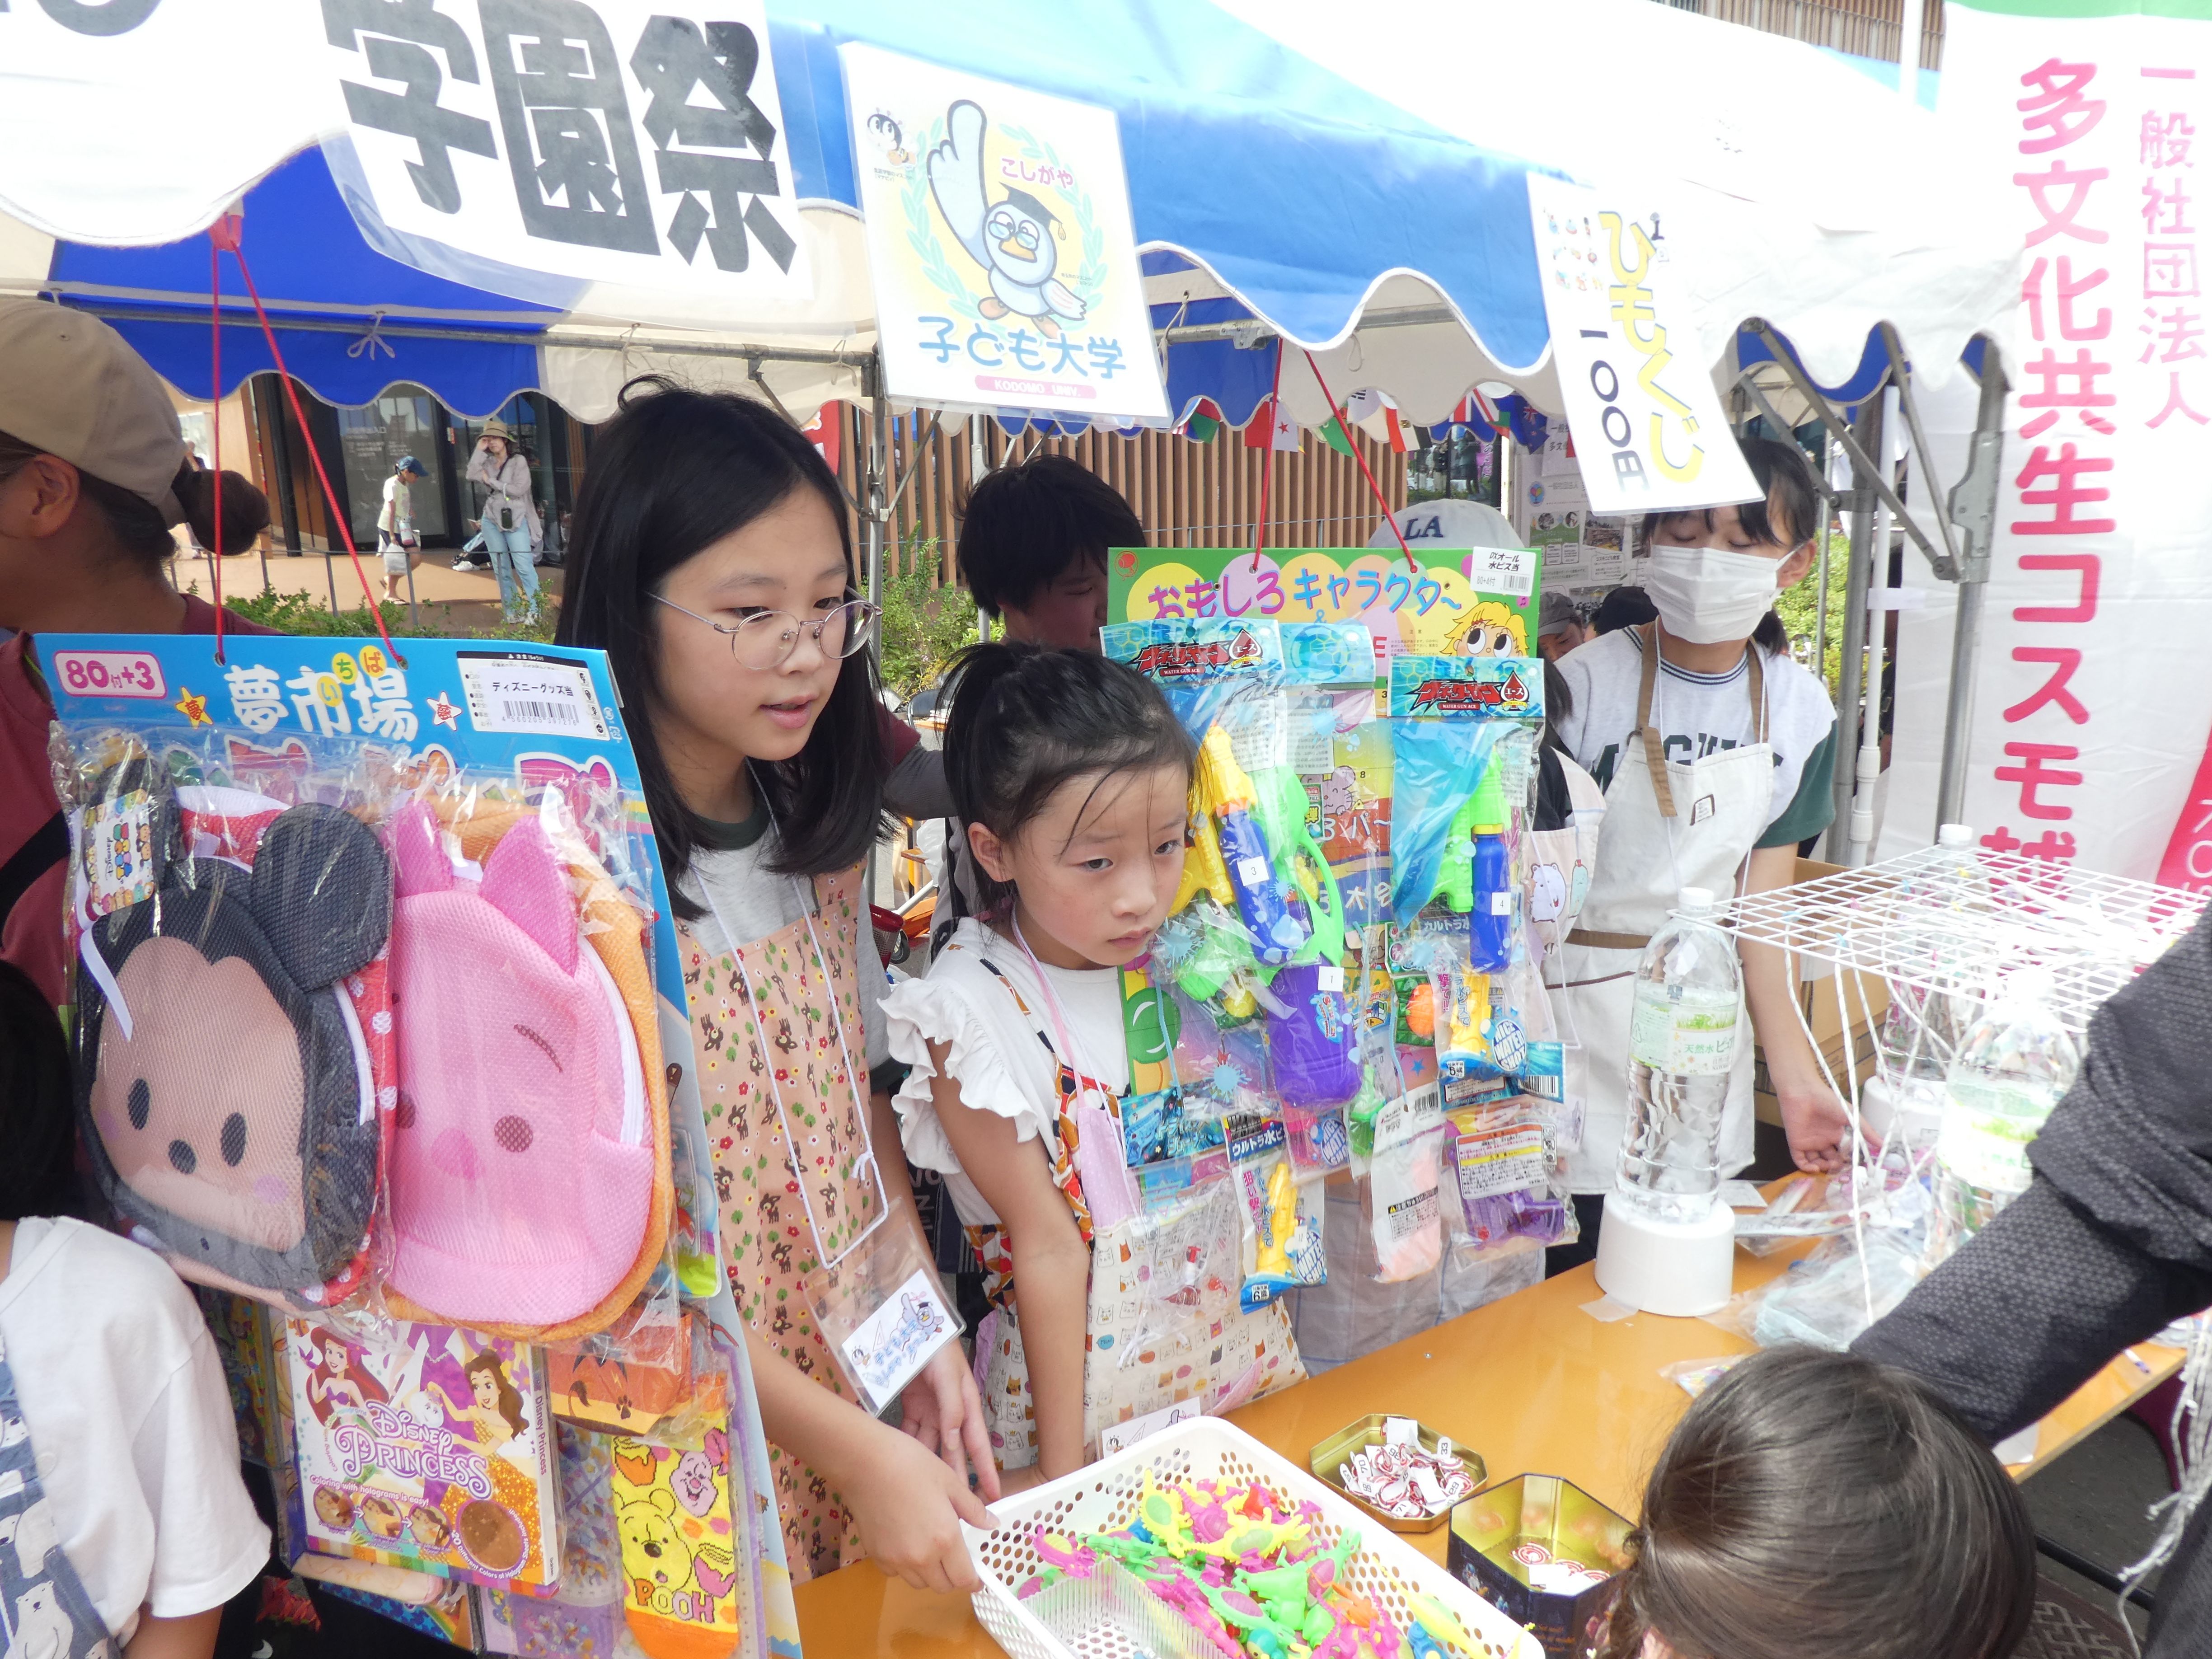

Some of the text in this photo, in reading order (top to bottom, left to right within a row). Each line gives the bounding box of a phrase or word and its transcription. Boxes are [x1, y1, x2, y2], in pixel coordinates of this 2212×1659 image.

[321, 0, 797, 276] 学園祭
[1001, 158, 1074, 189] こしがや
[2138, 66, 2211, 430] 一般社団法人
[918, 315, 1126, 379] 子ども大学
[994, 380, 1081, 397] KODOMO UNIV.
[1404, 516, 1444, 541] LA
[1489, 552, 1519, 562] DXオール
[1148, 570, 1285, 619] おもしろ
[1234, 642, 1256, 653] エース
[492, 682, 573, 696] ディズニーグッズ当
[1505, 687, 1524, 696] エース
[224, 664, 418, 742] 夢市場
[1251, 867, 1257, 876] 3
[1496, 1021, 1515, 1042] NICE
[1494, 1031, 1524, 1061] WATER
[1684, 1044, 1714, 1054] 天然水
[1501, 1047, 1526, 1070] SHOT
[1298, 1233, 1303, 1242] 12
[538, 1432, 547, 1476] Princess
[1441, 1442, 1448, 1455] 33
[1359, 1459, 1368, 1474] 70
[310, 1475, 429, 1507] Coloring with holograms is easy!
[452, 1530, 462, 1546] 20
[457, 1545, 480, 1571] Different
[479, 1568, 498, 1579] Colors
[508, 1508, 528, 1537] Included!
[634, 1579, 714, 1623] POOH
